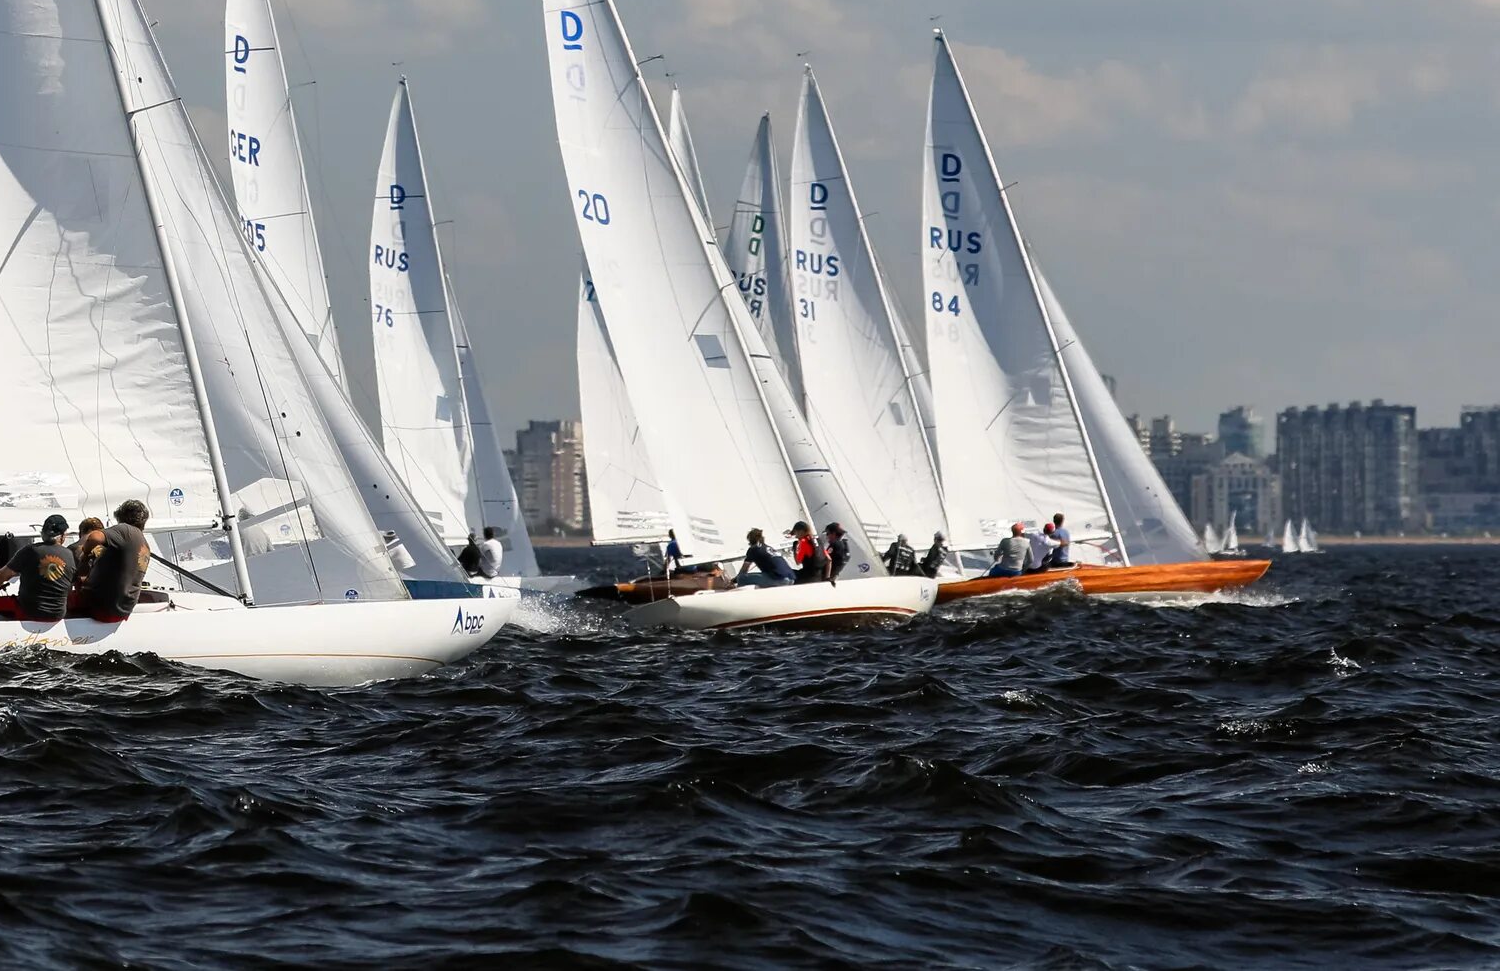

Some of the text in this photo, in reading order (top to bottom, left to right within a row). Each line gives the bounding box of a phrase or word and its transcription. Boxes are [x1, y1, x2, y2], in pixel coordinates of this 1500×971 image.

[560, 10, 583, 50] D
[234, 35, 250, 74] D
[230, 129, 261, 167] GER
[941, 153, 962, 182] D
[390, 184, 406, 210] D
[578, 189, 611, 226] 20
[810, 182, 828, 210] D
[930, 226, 982, 255] RUS
[375, 244, 409, 272] RUS
[796, 249, 840, 277] RUS
[730, 269, 766, 296] US
[375, 304, 394, 328] 76
[799, 298, 816, 322] 31
[932, 291, 961, 317] 84
